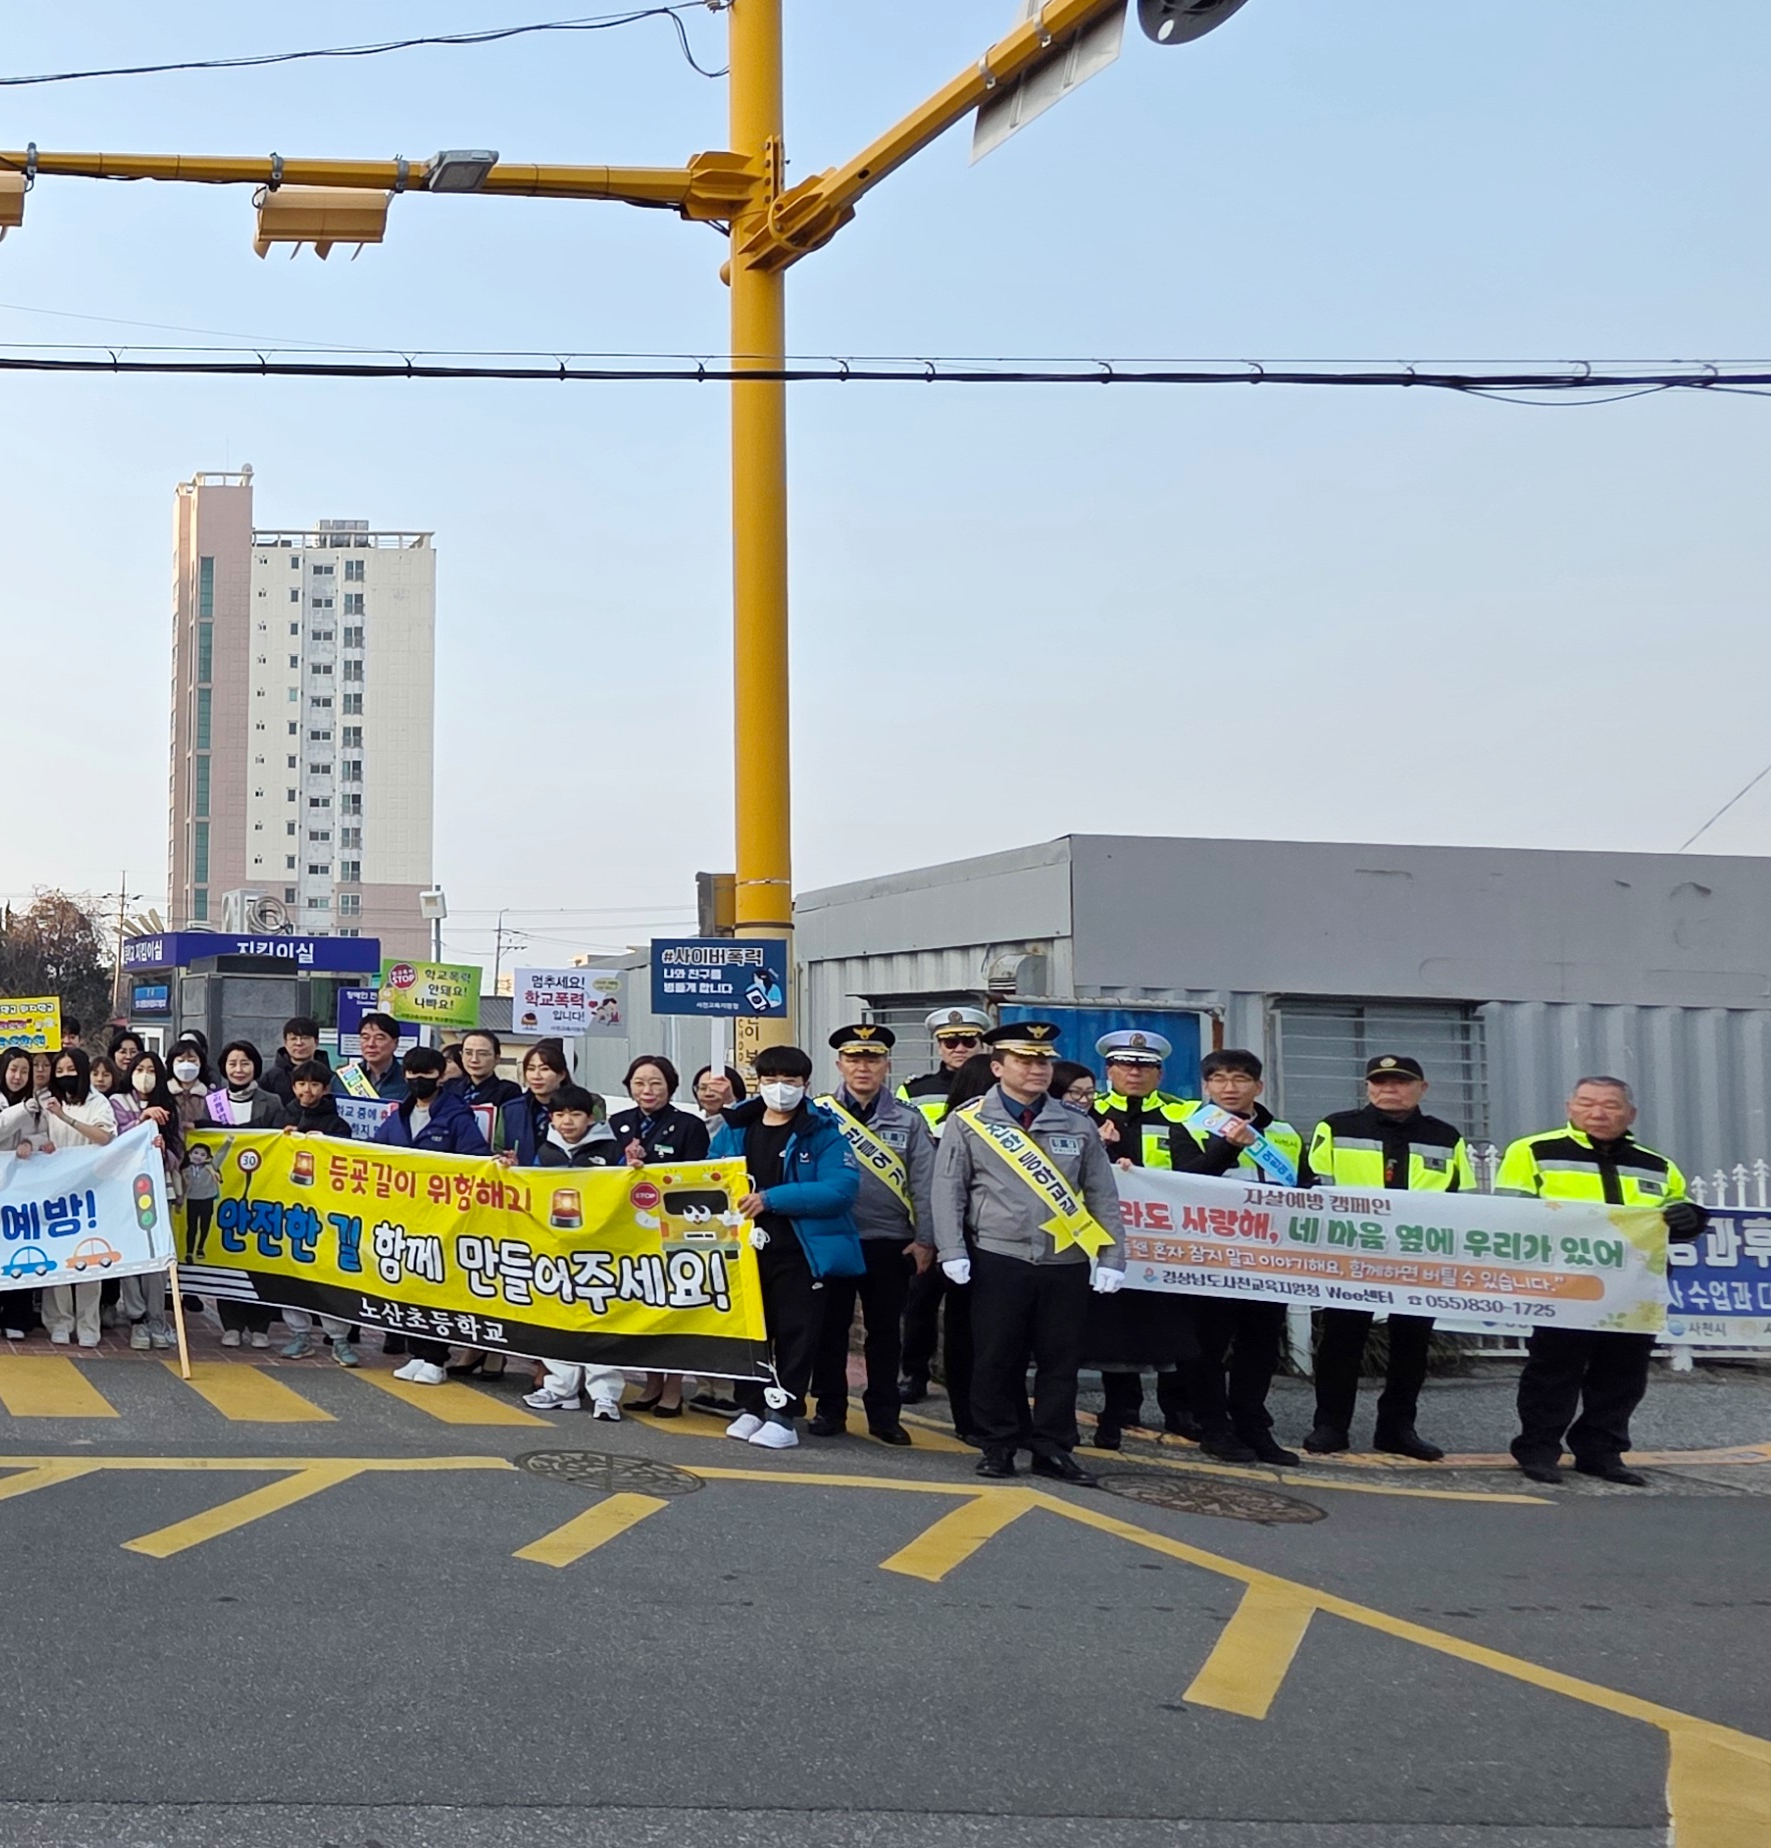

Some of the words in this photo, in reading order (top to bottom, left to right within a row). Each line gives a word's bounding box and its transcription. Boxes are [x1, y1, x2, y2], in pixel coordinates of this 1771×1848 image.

[662, 947, 764, 967] #사이버폭력
[392, 974, 415, 984] STOP
[532, 975, 585, 990] 멈추세요!
[663, 968, 686, 979] 나와
[525, 990, 585, 1009] 학교폭력
[699, 983, 734, 994] 합니다
[552, 1010, 585, 1022] 입니다!
[974, 1113, 1025, 1153] 전한
[241, 1155, 256, 1167] 30
[1243, 1188, 1324, 1211] 자살예방
[1329, 1196, 1391, 1215] 캠페인
[1, 1190, 97, 1240] 예방!
[1182, 1206, 1279, 1244] 사랑해,
[1288, 1216, 1320, 1245] 네
[1327, 1219, 1388, 1252] 마음
[1395, 1224, 1455, 1256] 옆에
[1463, 1229, 1553, 1263] 우리가
[1560, 1237, 1625, 1269] 있어
[217, 1197, 323, 1263] 안전한
[329, 1213, 363, 1273] 길
[373, 1220, 445, 1284] 함께
[455, 1235, 731, 1315] 만들어주세요!
[1153, 1241, 1185, 1261] 혼자
[1188, 1244, 1222, 1264] 참지
[1226, 1247, 1256, 1266] 말고
[1259, 1255, 1345, 1276] 이야기해요,
[1349, 1258, 1419, 1284] 함께하면
[1422, 1267, 1457, 1288] 버틸
[1461, 1270, 1480, 1287] 수
[1161, 1269, 1321, 1298] 경상남도사천교육지원청
[1688, 1281, 1753, 1312] 수업과
[358, 1297, 508, 1344] 노산초등학교
[1689, 1322, 1727, 1337] 사천시
